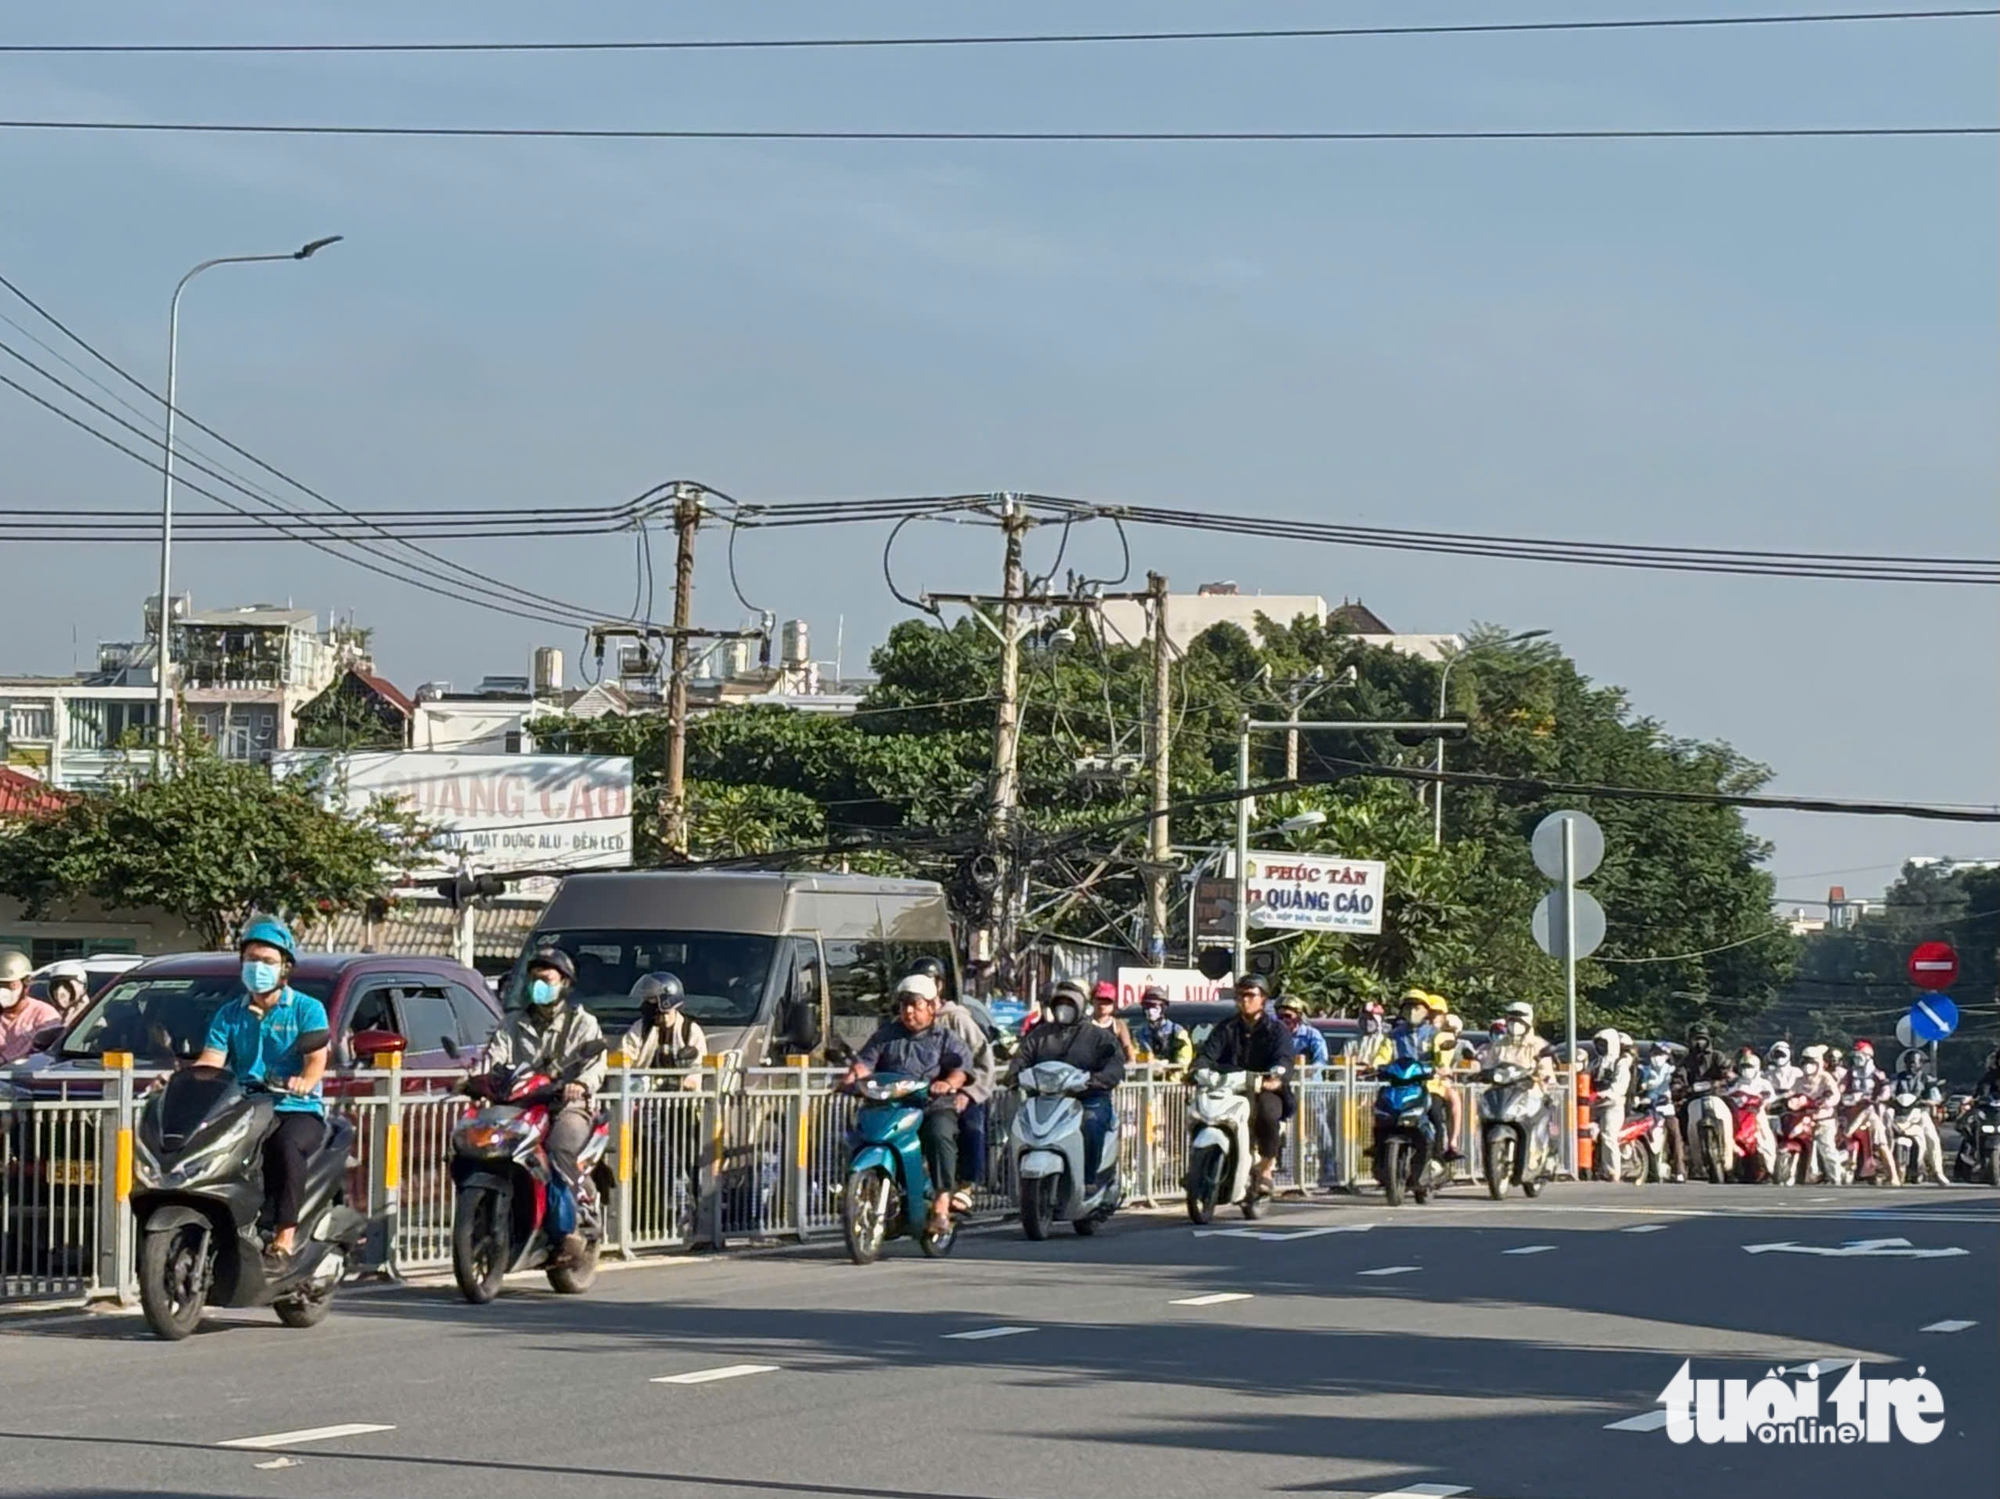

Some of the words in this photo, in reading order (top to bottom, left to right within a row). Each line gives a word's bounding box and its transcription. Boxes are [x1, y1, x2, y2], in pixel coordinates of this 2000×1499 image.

[538, 833, 561, 848] ALU
[1265, 864, 1322, 883] PHÚC
[1325, 866, 1369, 885] TÂN
[1266, 883, 1330, 912] QUẢNG
[1335, 888, 1374, 914] CÁO
